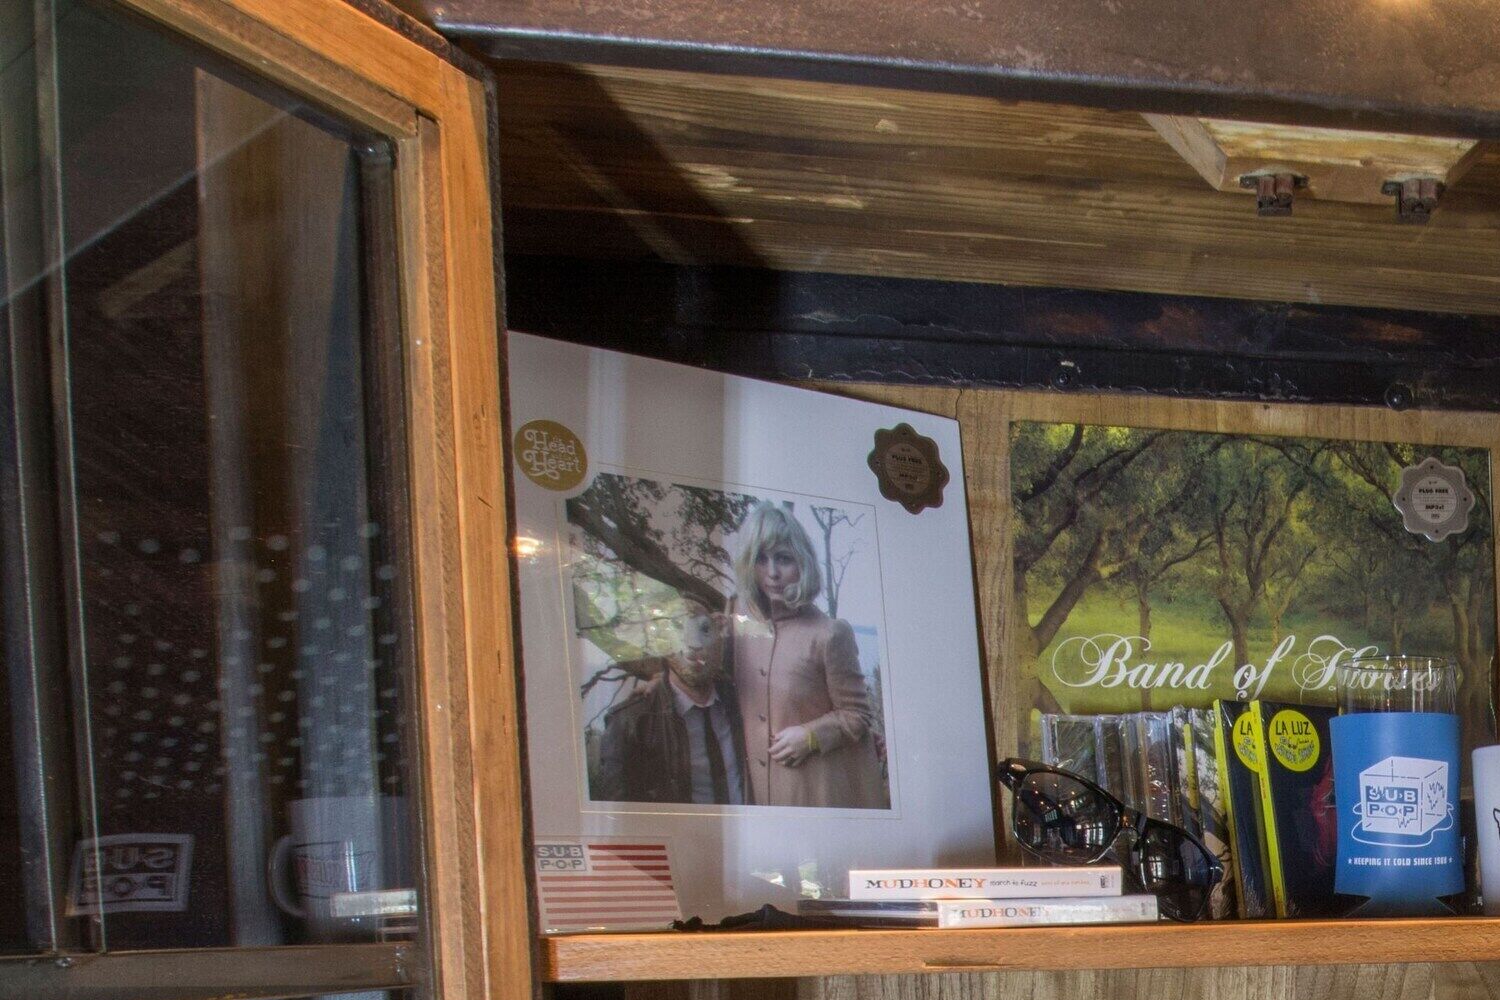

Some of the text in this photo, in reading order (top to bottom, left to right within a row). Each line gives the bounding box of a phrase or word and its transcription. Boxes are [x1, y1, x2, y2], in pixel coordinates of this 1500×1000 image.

[524, 430, 576, 455] Head
[522, 450, 582, 480] Heart
[1053, 634, 1233, 689] Band
[1233, 635, 1296, 701] of
[1240, 720, 1254, 735] LA
[1275, 721, 1312, 735] LA LUZ
[1368, 788, 1416, 802] SUB
[1369, 804, 1415, 817] POP
[537, 846, 581, 858] SUB
[540, 859, 583, 870] POP
[1353, 857, 1381, 866] KEEPING
[1384, 858, 1391, 866] IT
[1393, 857, 1411, 866] COLD
[1413, 857, 1432, 866] SINCE
[865, 878, 987, 888] MUDHONEY
[1020, 879, 1038, 887] fuzz
